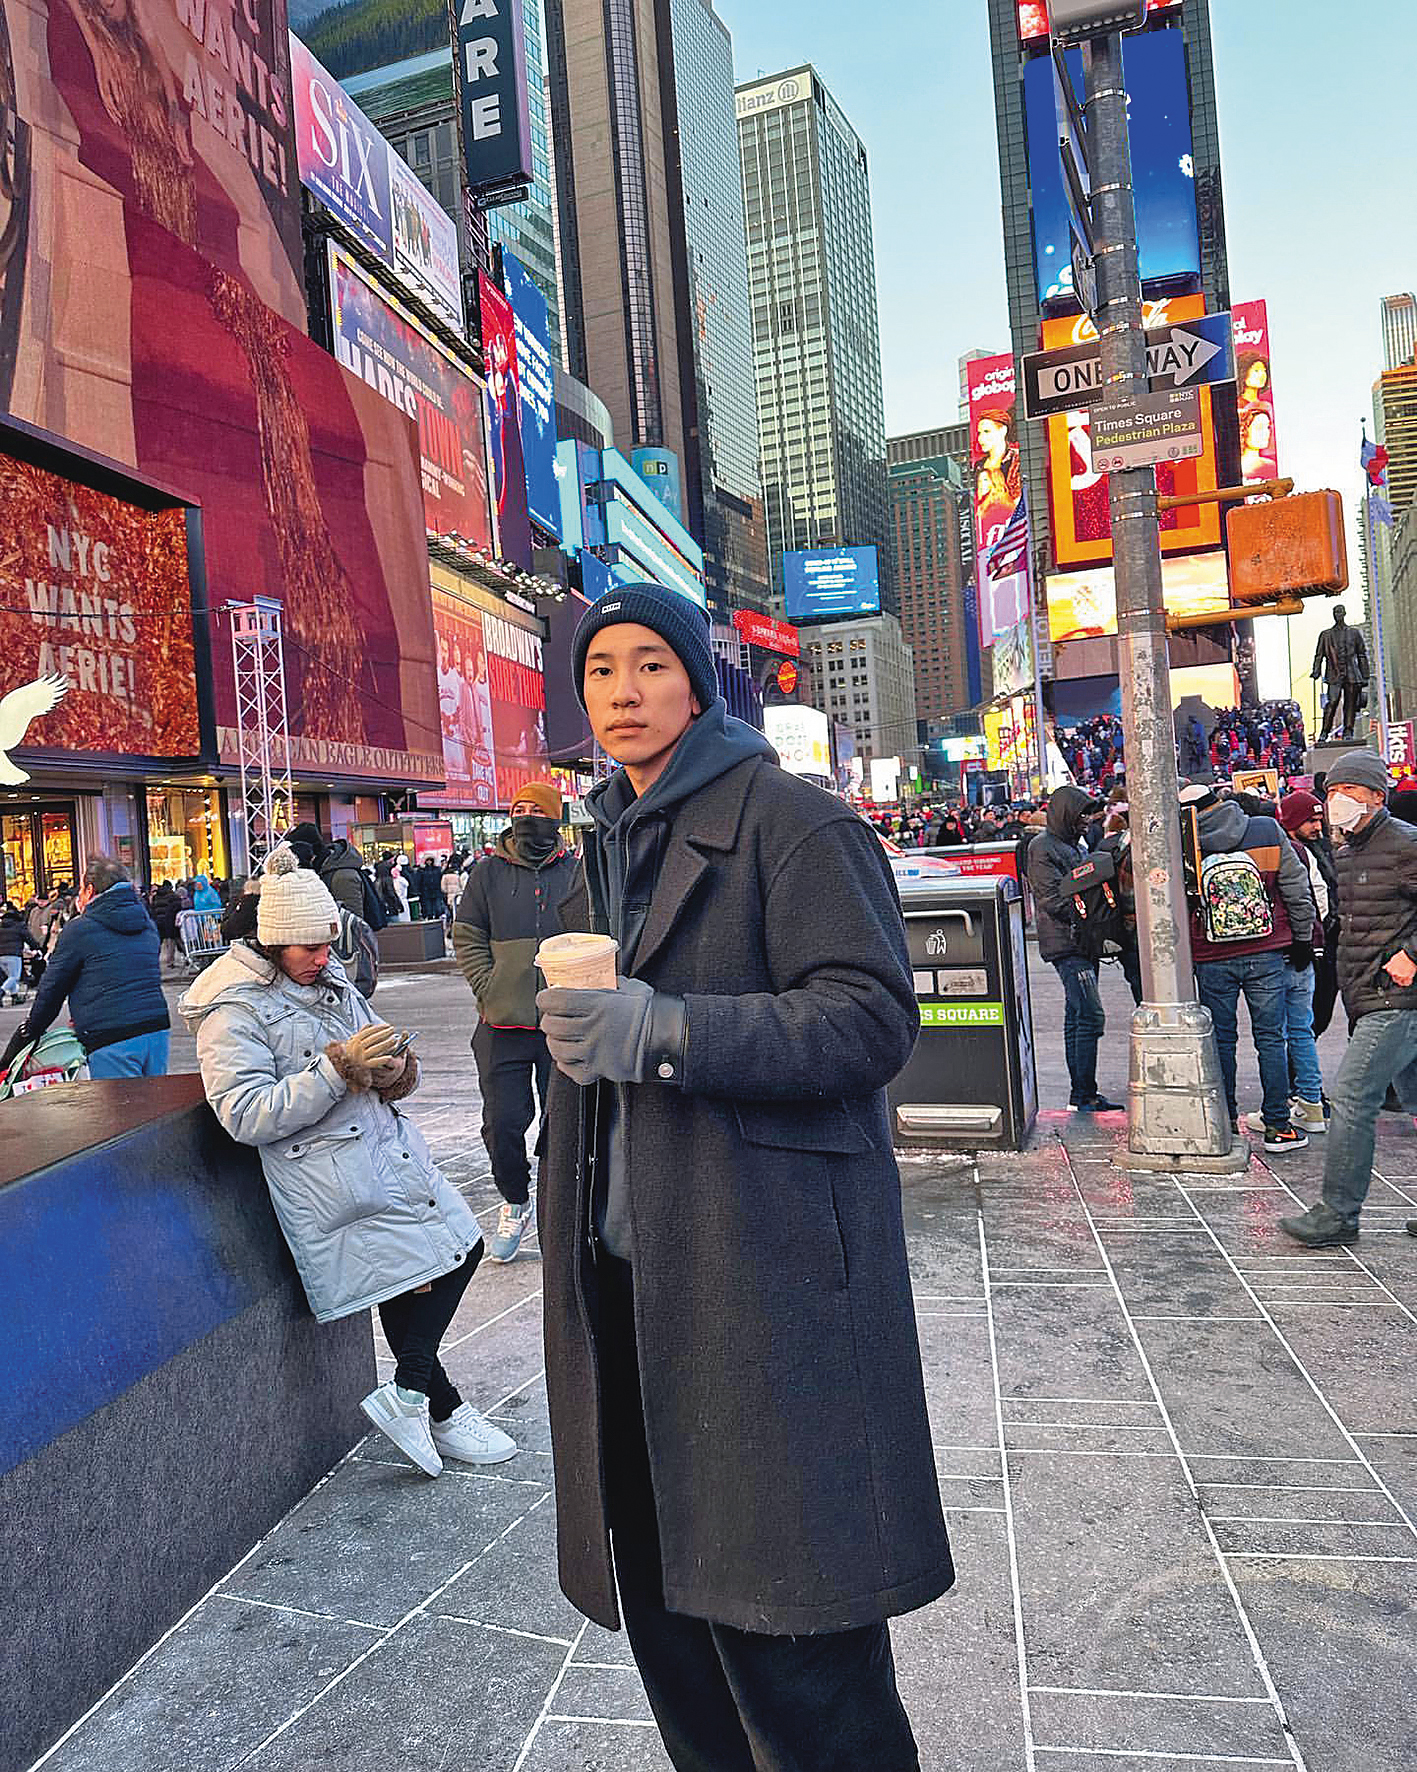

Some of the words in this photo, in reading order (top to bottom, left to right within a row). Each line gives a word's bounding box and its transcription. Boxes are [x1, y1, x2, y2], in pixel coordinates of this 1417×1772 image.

[183, 52, 288, 197] AERIE!
[1094, 417, 1133, 433] Times
[1135, 409, 1182, 425] Square
[1095, 426, 1160, 447] Pedestrian
[1162, 422, 1196, 434] Plaza
[47, 524, 111, 581] NYC
[25, 577, 136, 644] WANTS
[37, 641, 136, 699] AERIE!
[484, 611, 544, 673] BROADWAY'S
[1389, 726, 1407, 763] tkts
[937, 1008, 999, 1021] SQUARE
